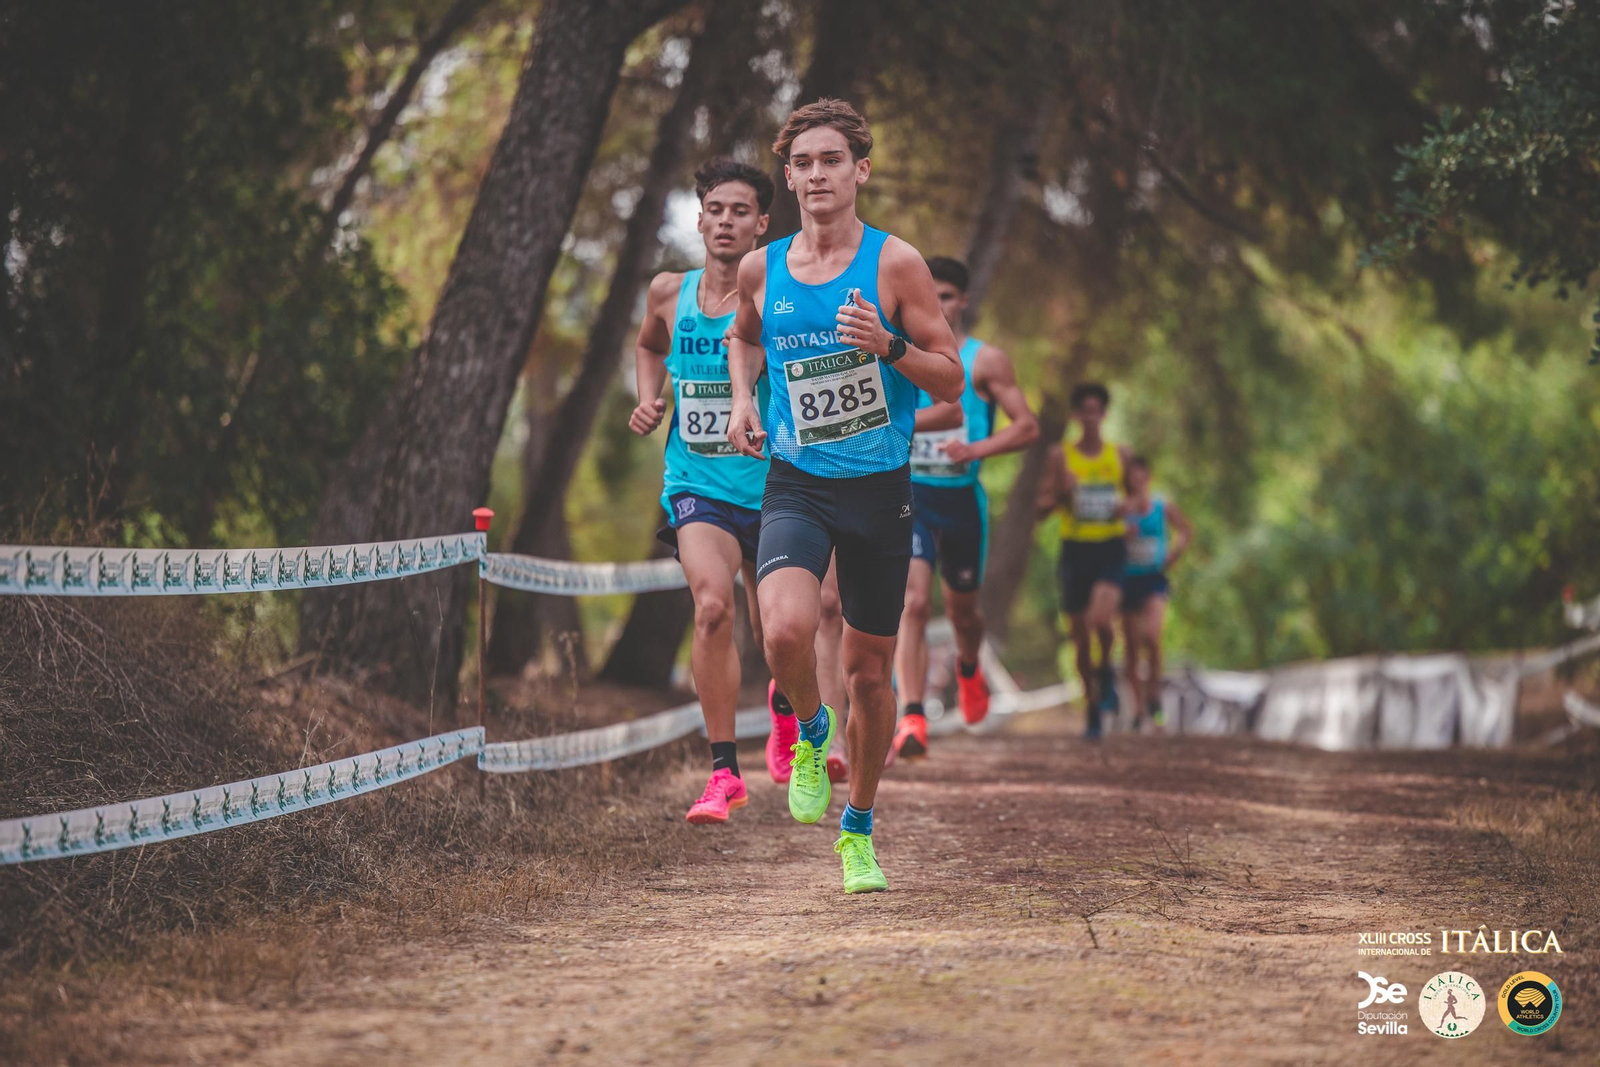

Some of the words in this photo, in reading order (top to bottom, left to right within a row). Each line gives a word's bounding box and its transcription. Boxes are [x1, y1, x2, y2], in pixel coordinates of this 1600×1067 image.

[690, 364, 728, 375] ATLETIS
[808, 355, 853, 372] ITÁLICA
[698, 384, 732, 395] ITÁLIC
[799, 377, 877, 422] 8285
[687, 411, 731, 435] 827
